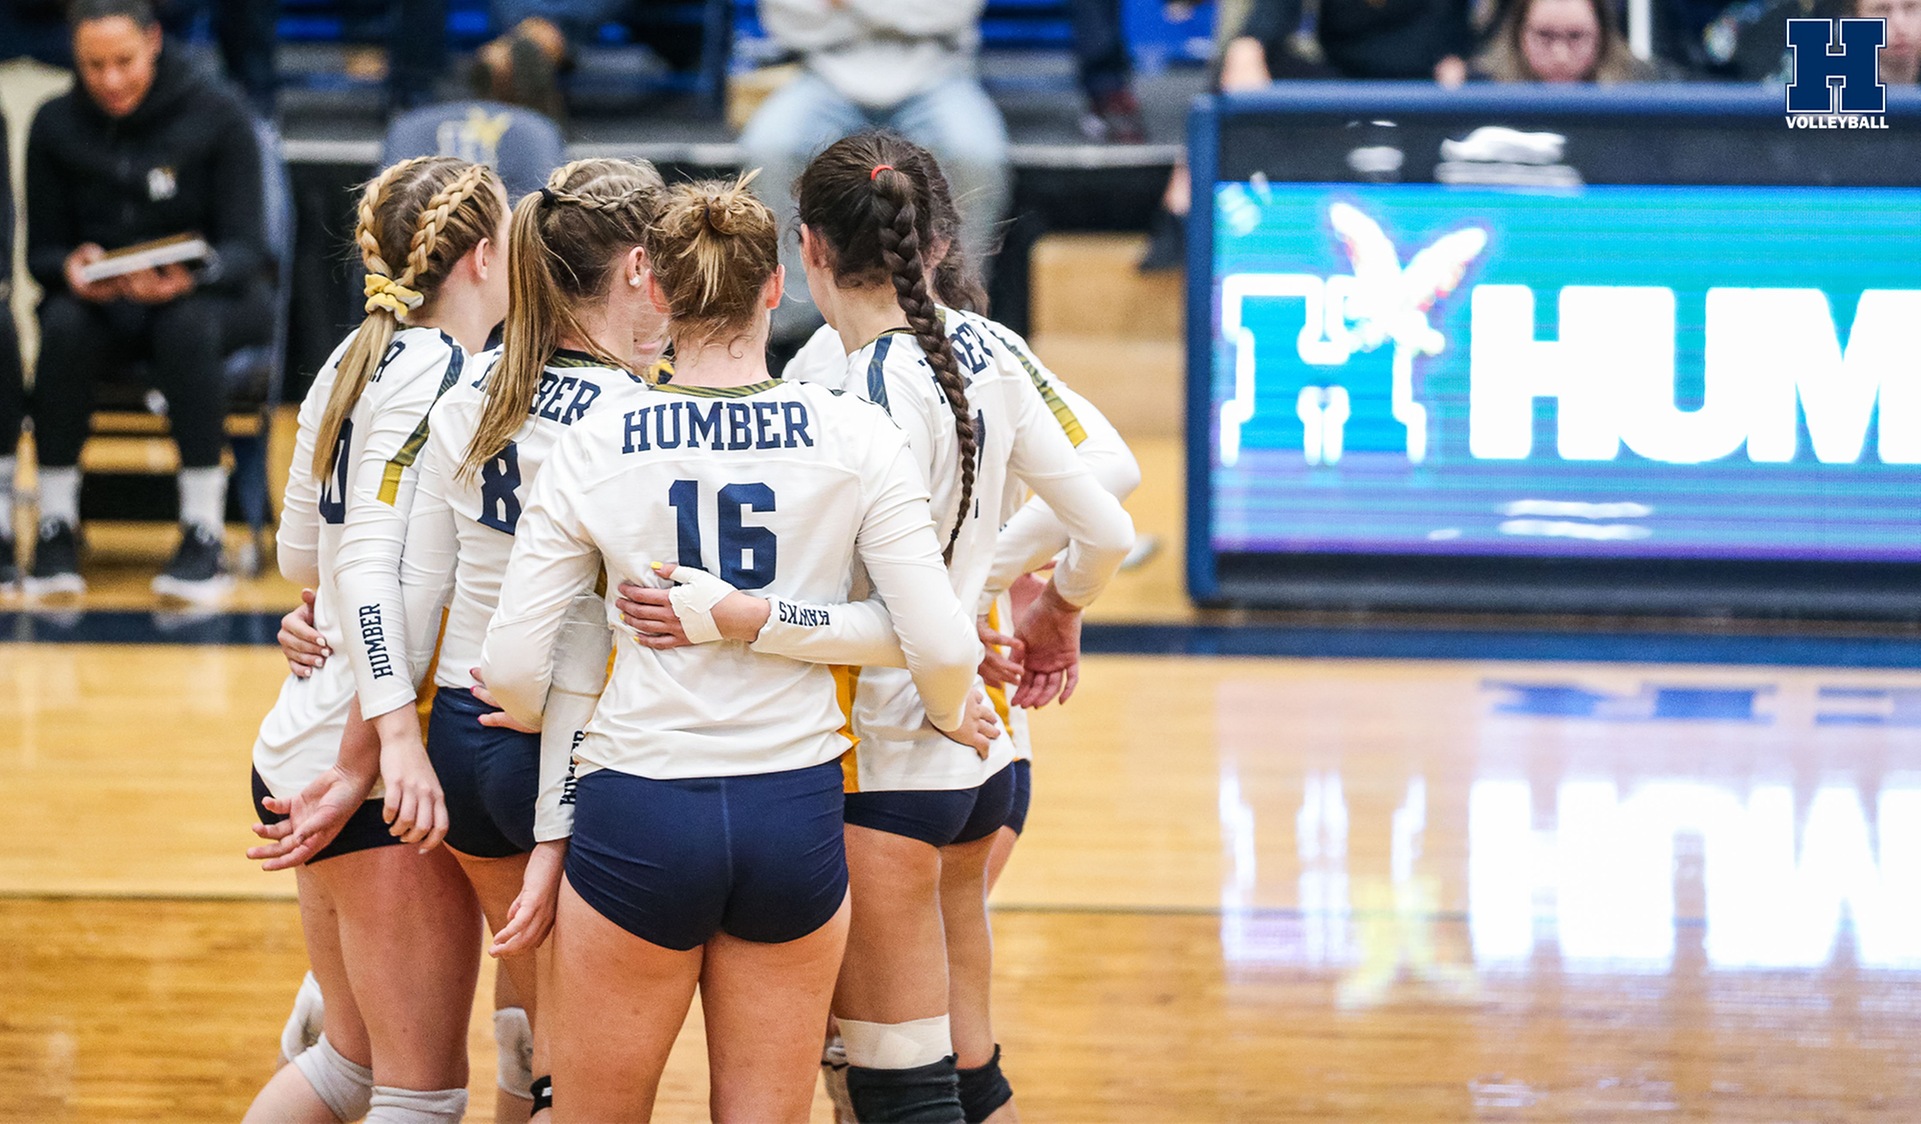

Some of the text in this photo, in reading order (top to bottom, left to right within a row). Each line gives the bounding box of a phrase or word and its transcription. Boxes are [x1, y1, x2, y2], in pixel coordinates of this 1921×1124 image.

[622, 401, 814, 454] HUMBER
[477, 440, 522, 536] 8
[668, 479, 777, 590] 16
[359, 603, 394, 680] HUMBER
